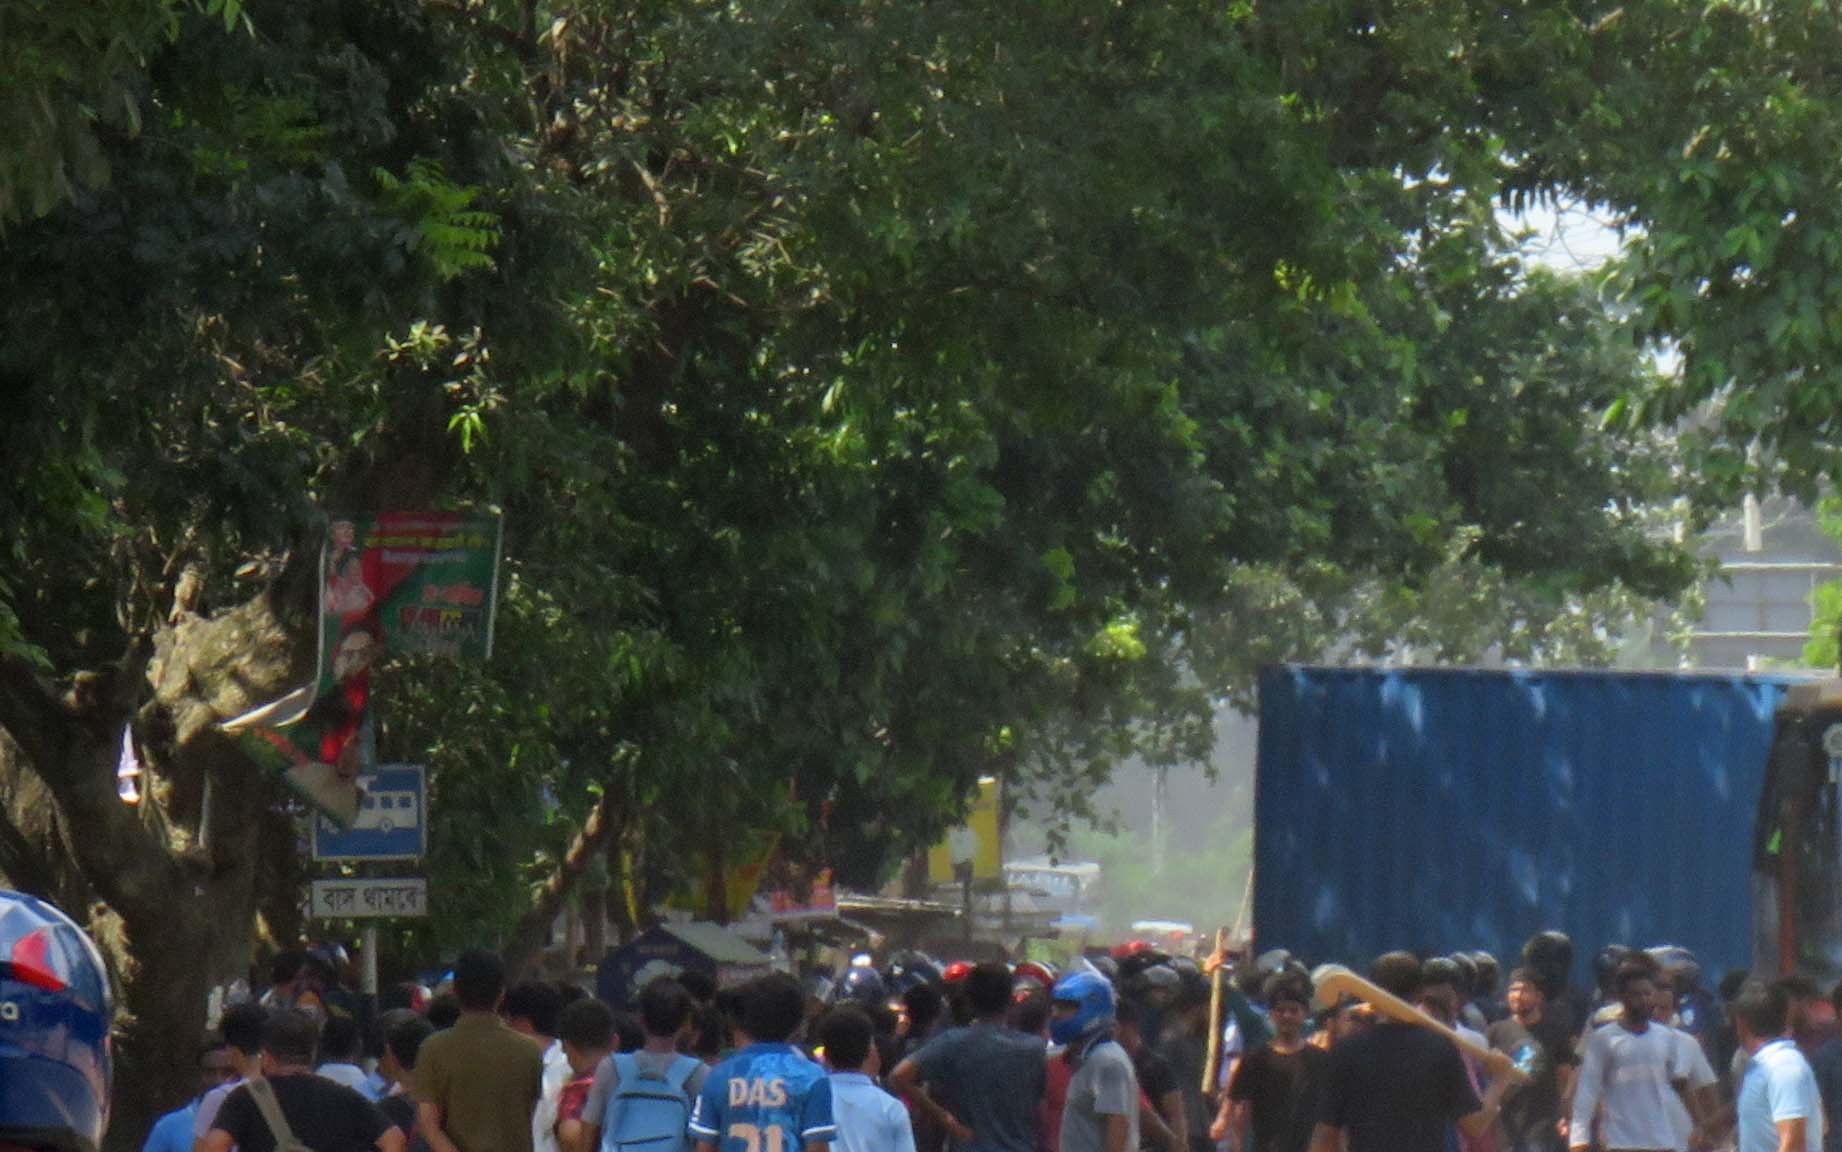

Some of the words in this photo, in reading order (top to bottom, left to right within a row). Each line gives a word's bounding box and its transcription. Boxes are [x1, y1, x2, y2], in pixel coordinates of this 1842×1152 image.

[321, 887, 356, 911] বাস
[363, 887, 418, 911] থামবে
[728, 1077, 788, 1109] DAS
